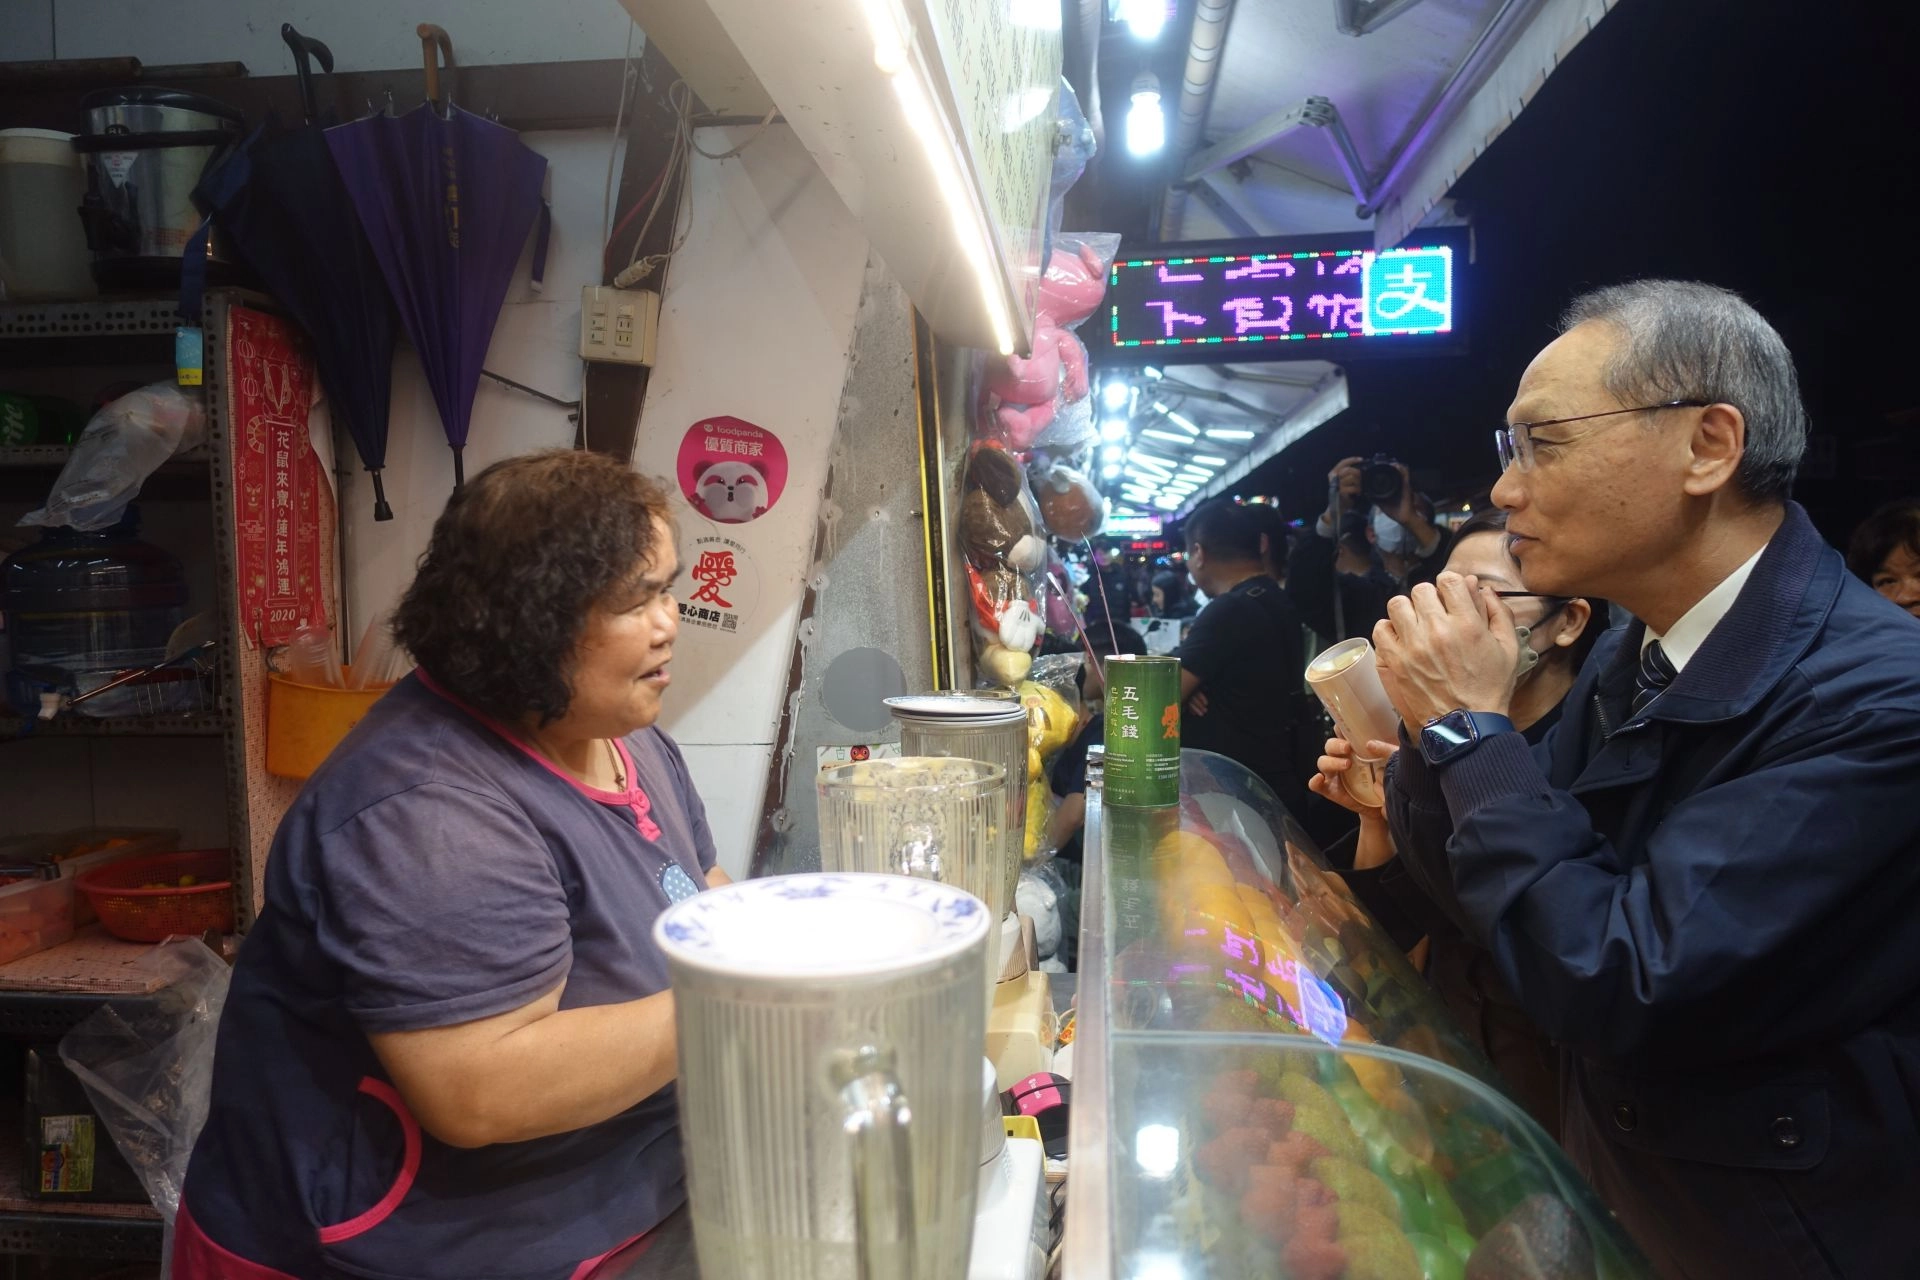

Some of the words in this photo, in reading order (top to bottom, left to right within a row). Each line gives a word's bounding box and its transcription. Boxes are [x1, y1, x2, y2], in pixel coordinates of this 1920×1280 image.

[717, 425, 763, 439] foodpanda
[704, 435, 763, 457] 優質商家
[270, 608, 296, 622] 2020
[1121, 686, 1140, 739] 五毛錢
